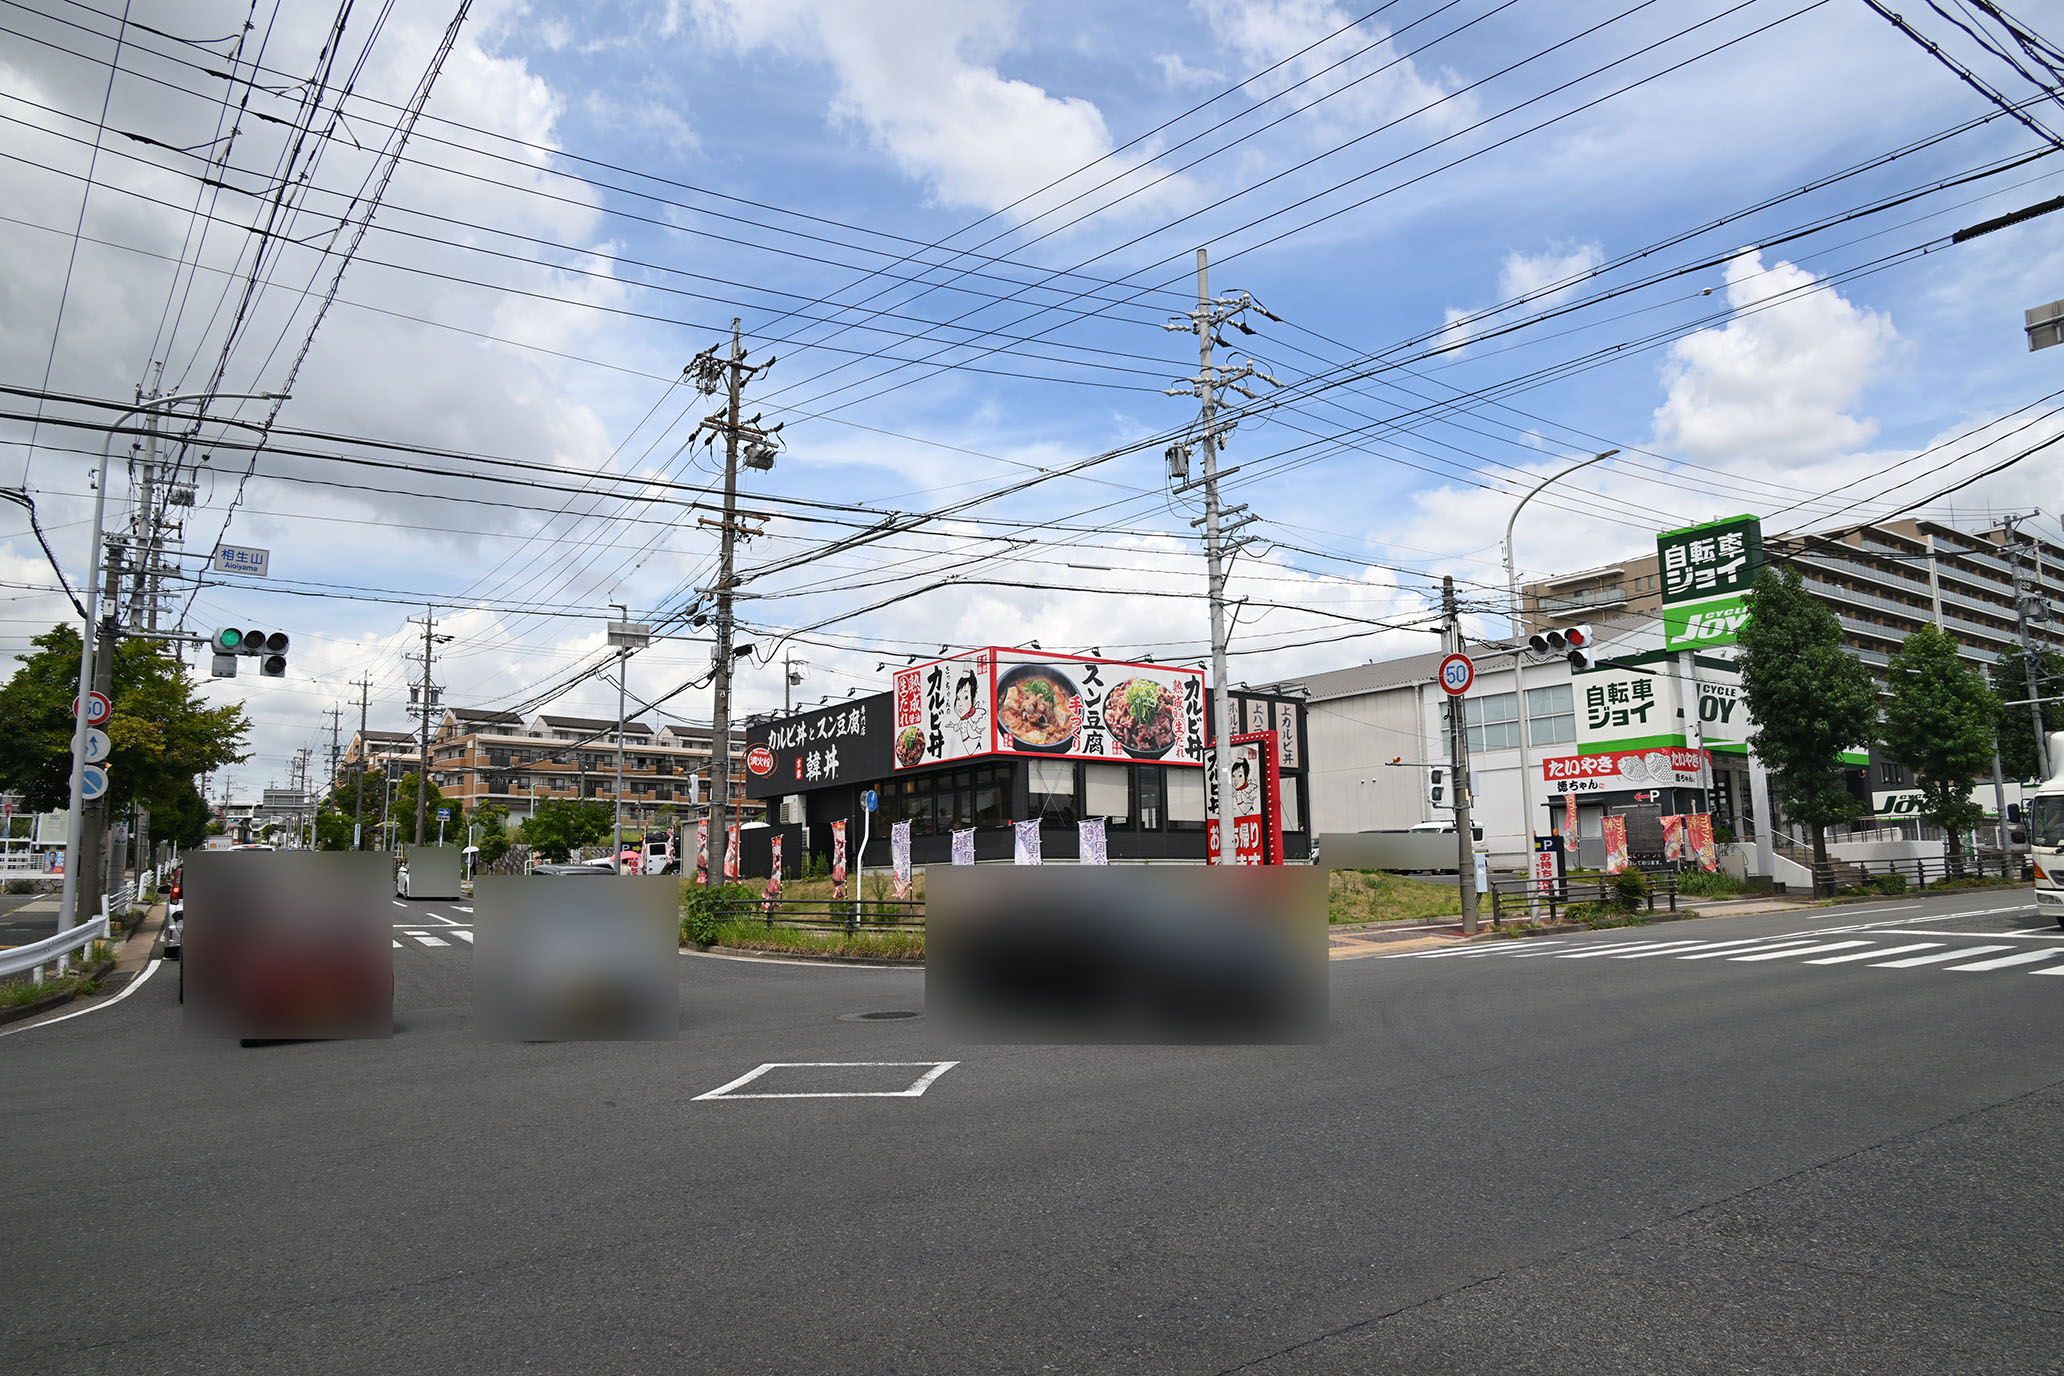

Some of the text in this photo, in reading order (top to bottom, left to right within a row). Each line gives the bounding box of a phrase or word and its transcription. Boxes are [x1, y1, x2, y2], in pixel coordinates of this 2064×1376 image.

[221, 548, 264, 565] 相生山
[224, 561, 258, 572] Aioiyama
[1664, 532, 1745, 572] 自転車
[1666, 555, 1747, 595] ジョイ
[1670, 612, 1751, 644] JOY
[1446, 664, 1466, 684] 50
[1586, 678, 1654, 708] 自転車
[1702, 684, 1737, 697] CYCLE
[926, 665, 946, 759] カルビ丼
[1067, 695, 1085, 753] 手づくり
[1081, 664, 1106, 756] スン豆腐
[1183, 674, 1204, 762] カルビ丼
[1588, 701, 1655, 730] ジョイ
[767, 707, 861, 752] カルビ丼とスン豆腐
[805, 743, 840, 783] 韓丼
[1548, 755, 1614, 778] たいやき
[1671, 750, 1699, 769] たいやき
[1557, 778, 1599, 793] 徳ちゃん
[1649, 789, 1661, 803] P
[1543, 840, 1553, 851] P
